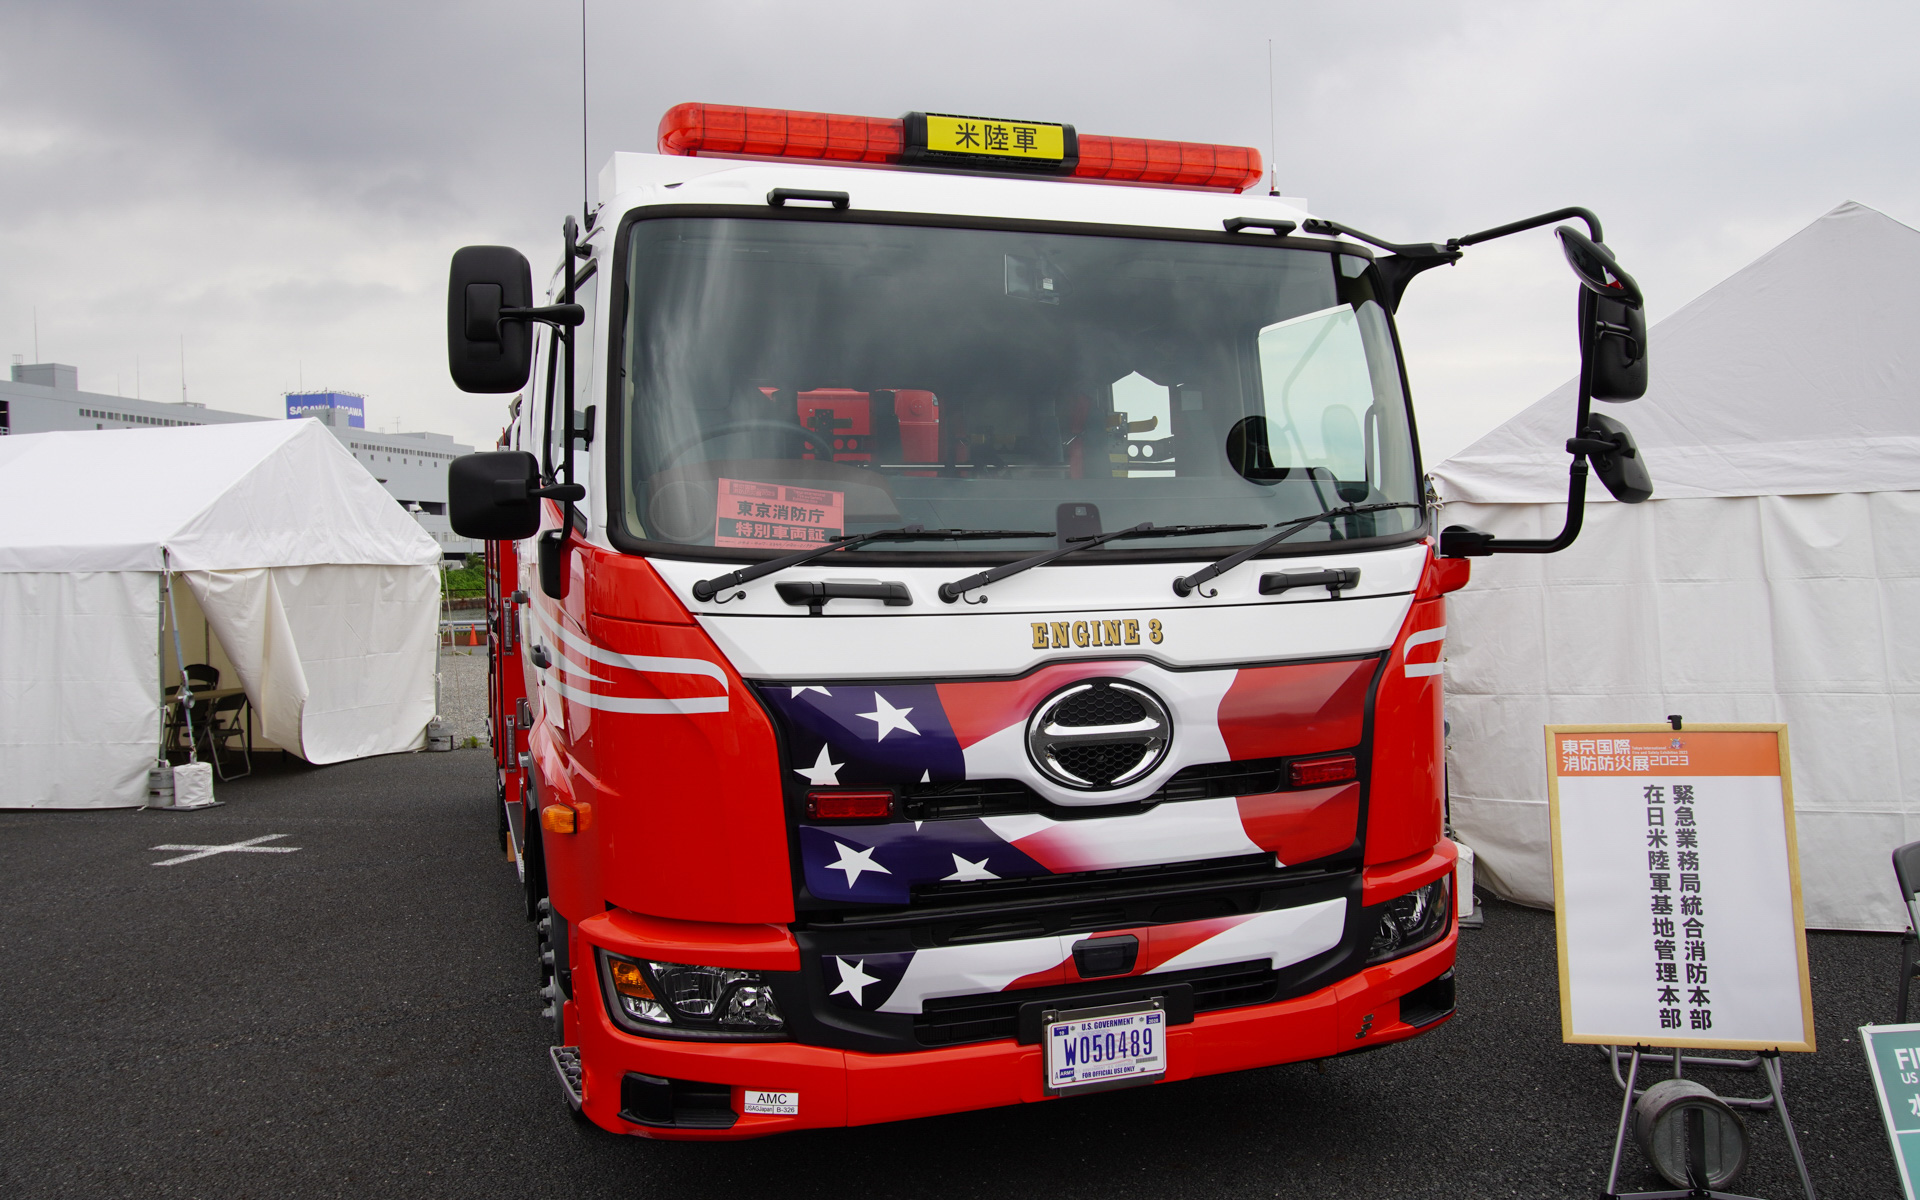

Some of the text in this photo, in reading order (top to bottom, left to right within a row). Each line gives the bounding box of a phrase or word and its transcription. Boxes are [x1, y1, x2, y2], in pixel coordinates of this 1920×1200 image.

[955, 122, 1038, 153] 米陸軍
[737, 500, 825, 523] 東京消防庁
[735, 521, 825, 542] 特別車両証
[1031, 618, 1163, 649] ENGINE 3
[1561, 739, 1631, 755] 東京国際
[1563, 755, 1689, 772] 消防防災展2023
[1643, 784, 1682, 1030] 在日米陸軍基地管理本部
[1672, 784, 1713, 1031] 緊急業務局統合消防本部
[1081, 1017, 1134, 1031] U.S. GOVERNMENT
[1064, 1028, 1152, 1067] W050489
[1092, 1069, 1113, 1077] OFFICIAL
[1124, 1065, 1135, 1073] ONLY
[1900, 1072, 1919, 1084] US
[757, 1093, 787, 1104] AMC
